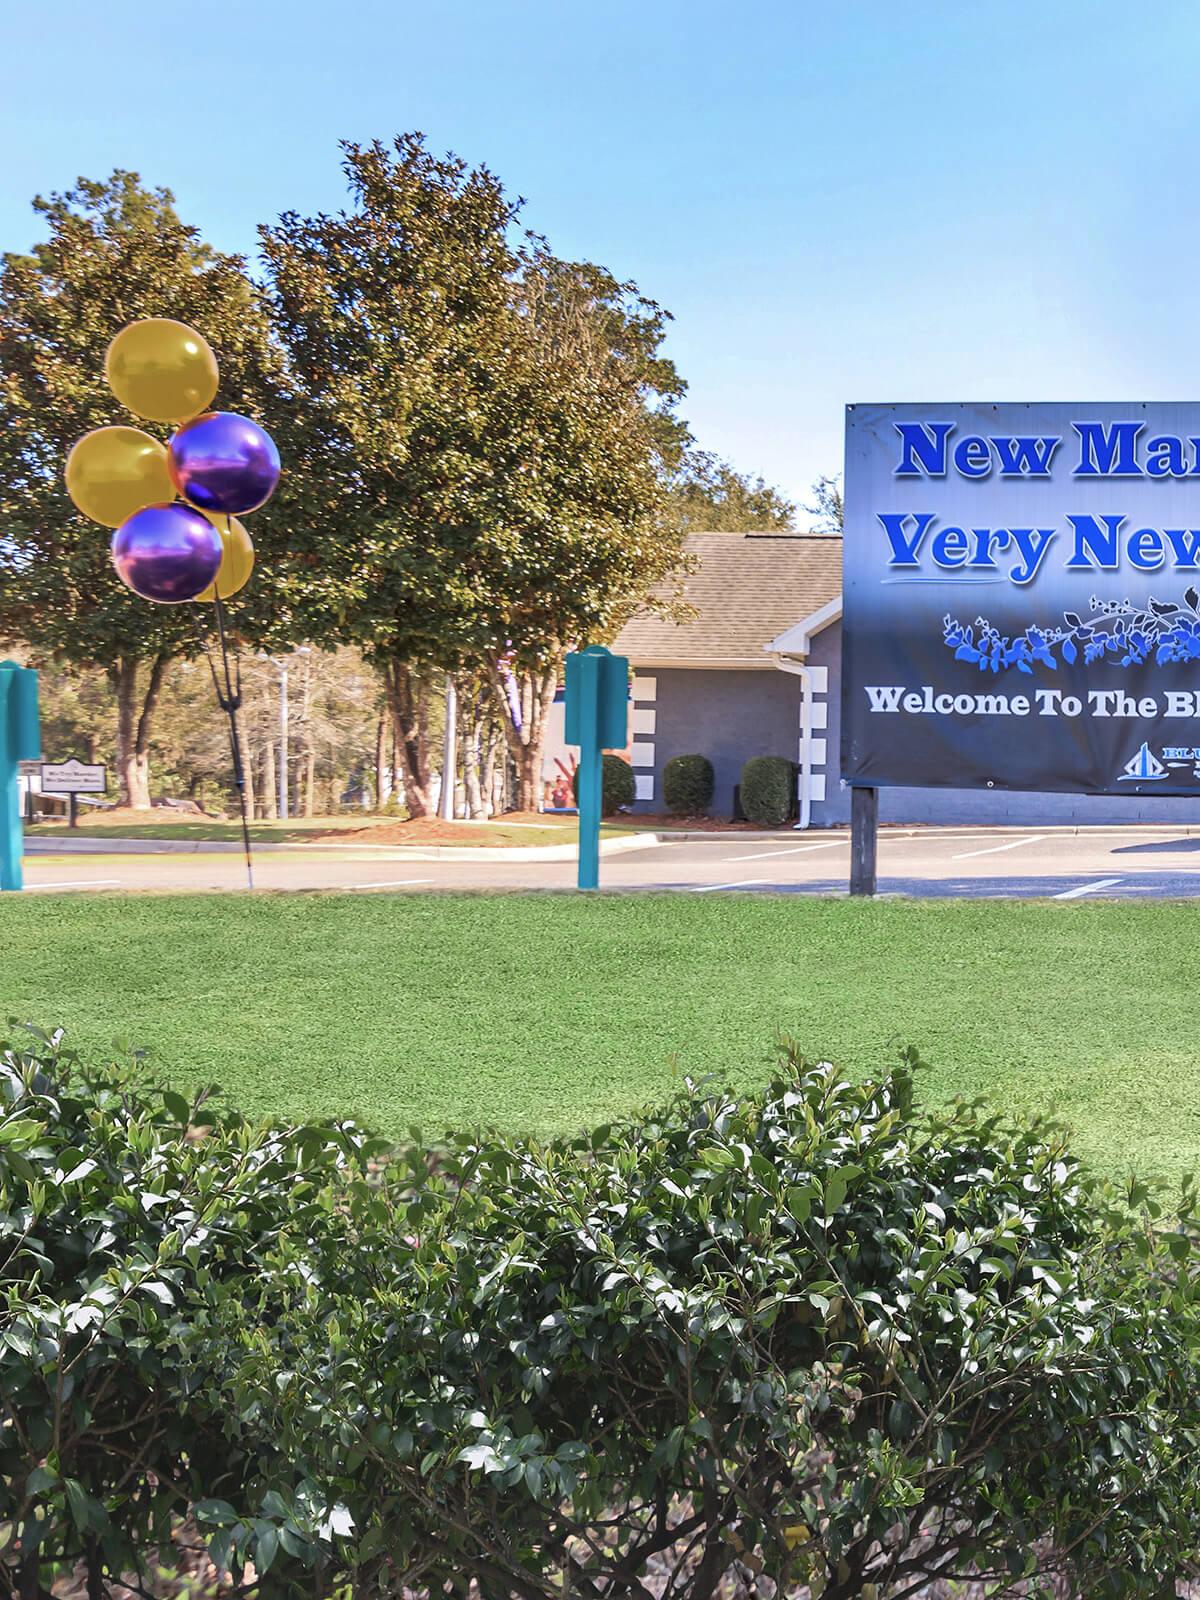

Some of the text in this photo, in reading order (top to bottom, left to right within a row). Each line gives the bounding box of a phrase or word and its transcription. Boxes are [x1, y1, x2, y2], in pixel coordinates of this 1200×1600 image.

[892, 421, 1063, 478] New
[875, 512, 1057, 584] Very
[864, 686, 1030, 715] Welcome
[1035, 689, 1082, 716] To
[1088, 690, 1157, 718] The
